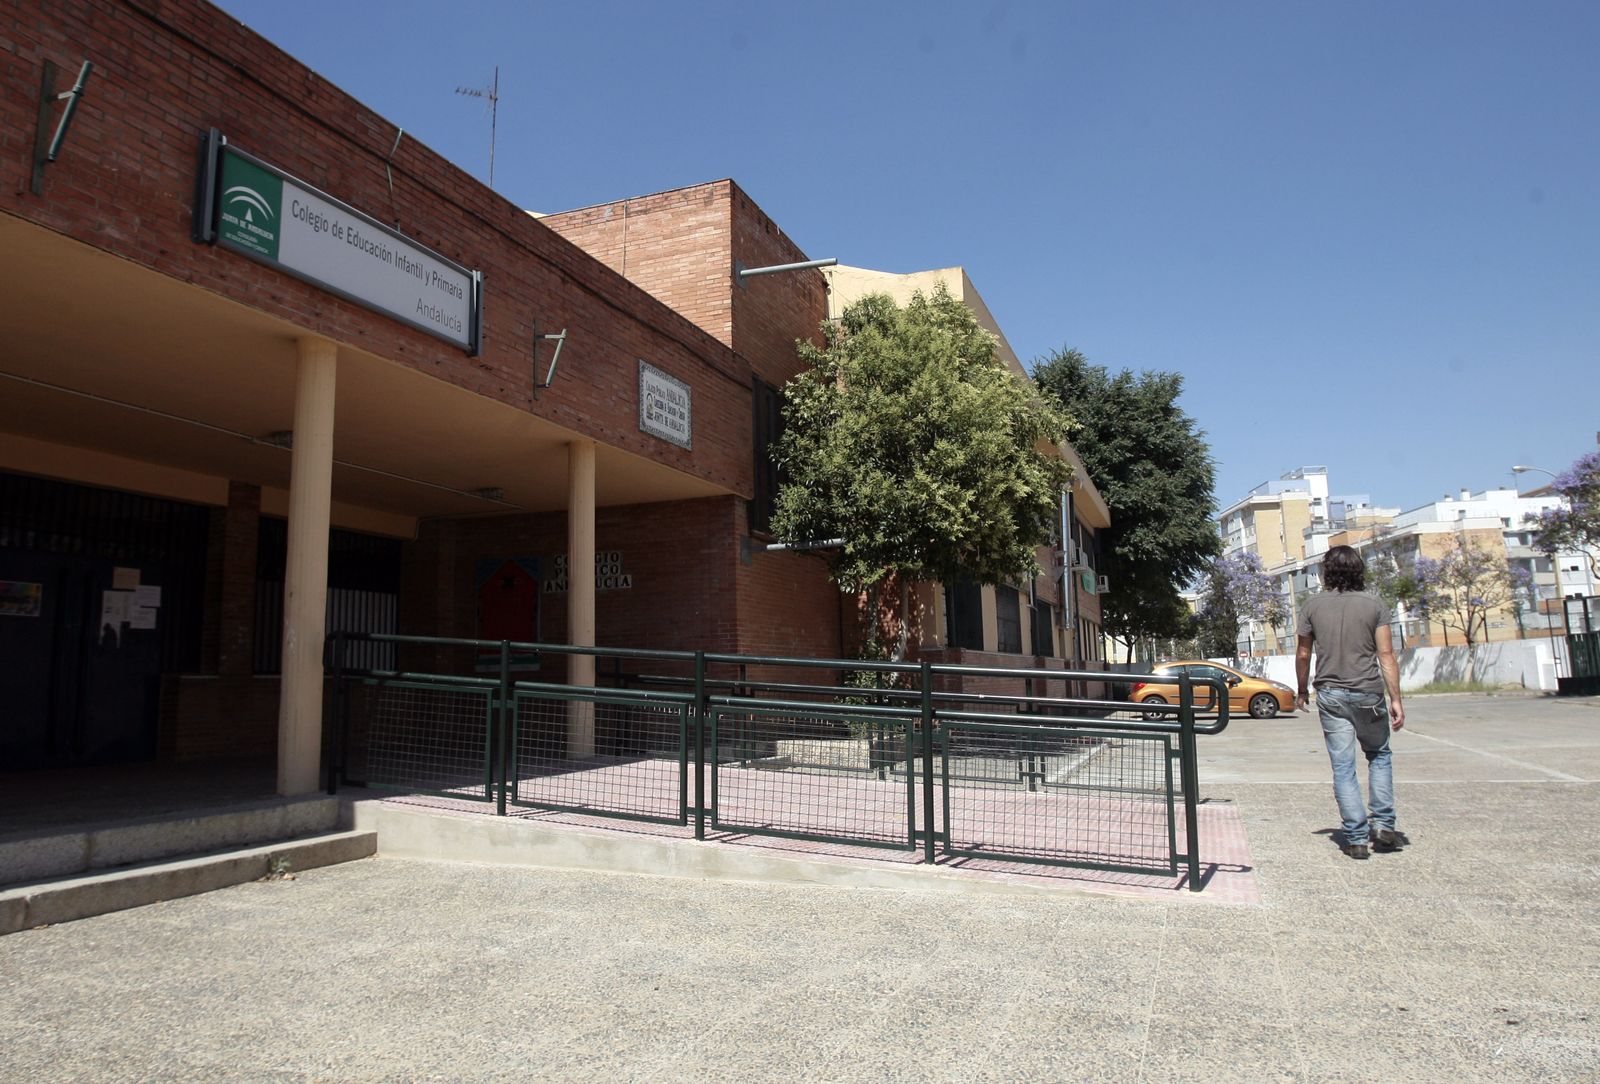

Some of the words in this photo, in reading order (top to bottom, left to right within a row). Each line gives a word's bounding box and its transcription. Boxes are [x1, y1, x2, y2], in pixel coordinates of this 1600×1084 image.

[291, 200, 329, 233] Colegio
[331, 221, 344, 240] de
[346, 227, 392, 264] Educación
[394, 251, 424, 281] Infantil
[425, 271, 431, 286] y
[432, 270, 463, 300] Primaria
[416, 298, 462, 333] Andalucía
[554, 552, 619, 566] CGIO
[546, 576, 630, 592] ANUCIA
